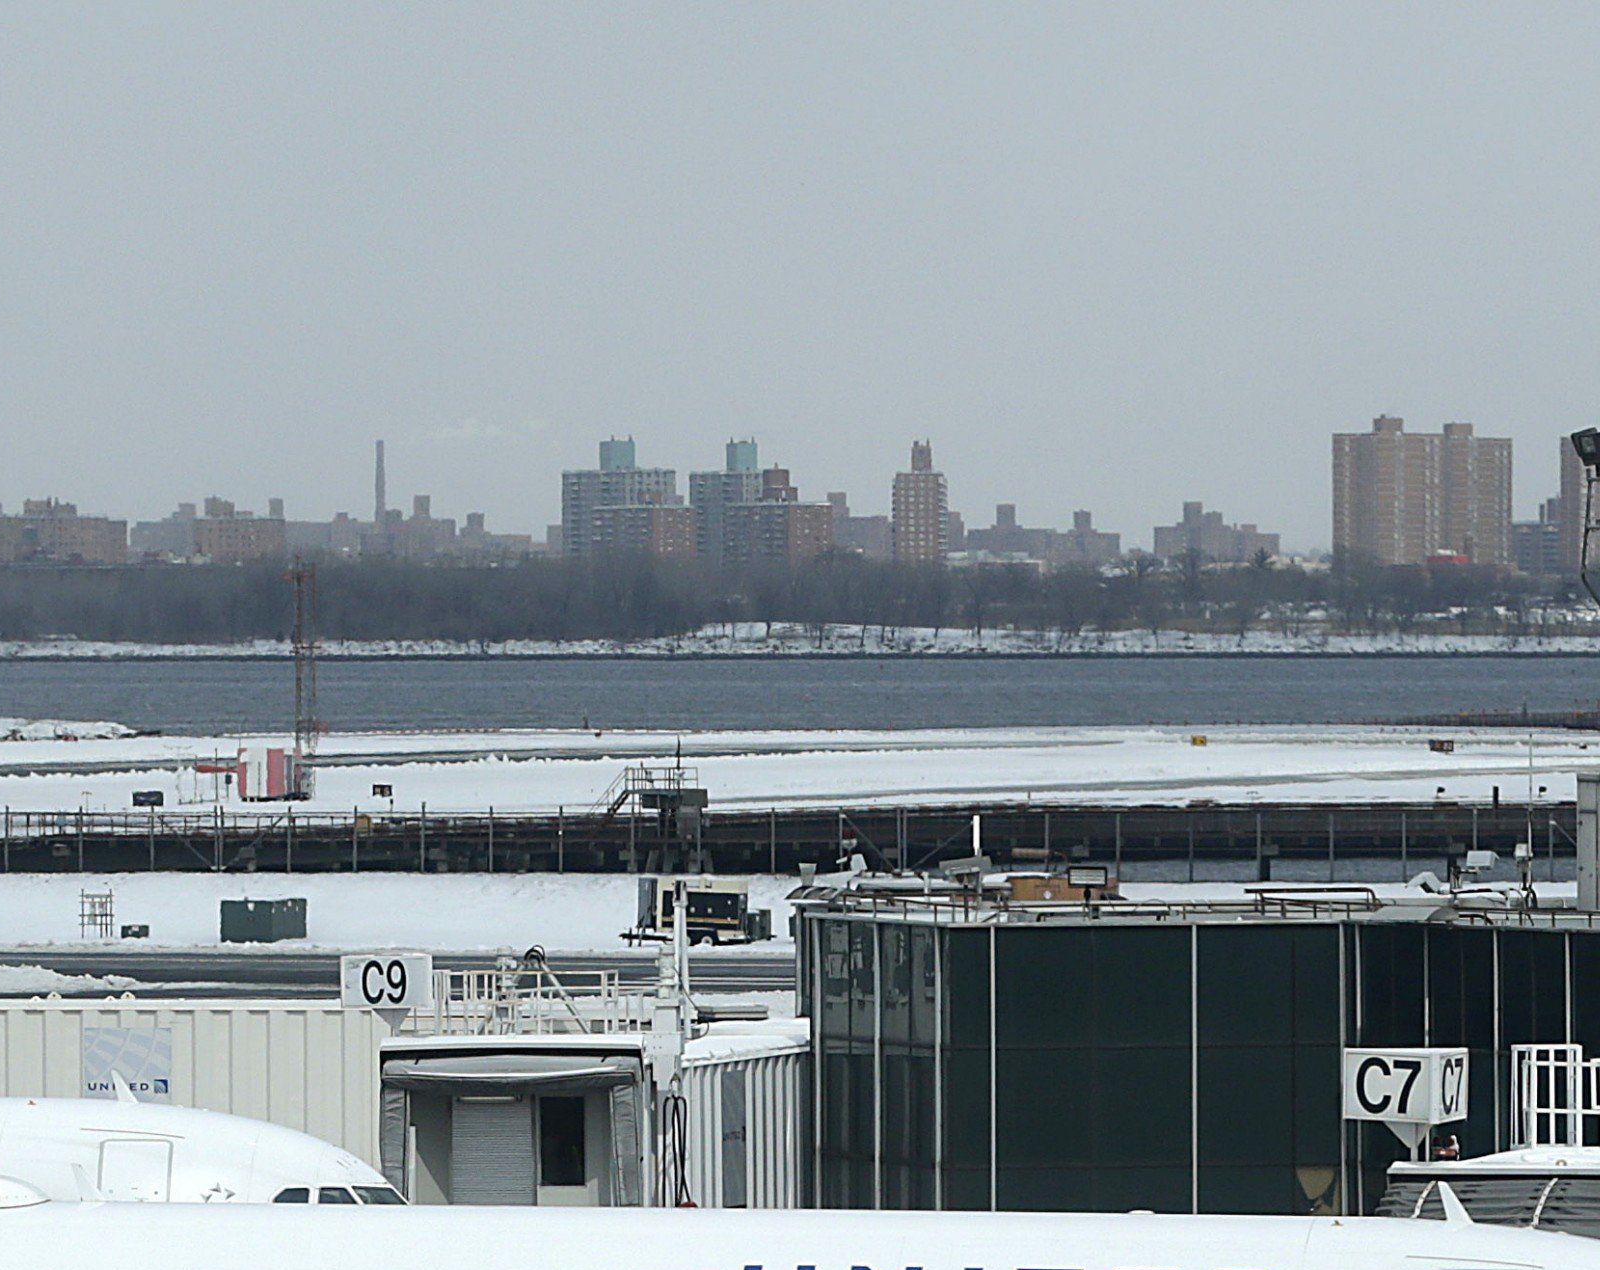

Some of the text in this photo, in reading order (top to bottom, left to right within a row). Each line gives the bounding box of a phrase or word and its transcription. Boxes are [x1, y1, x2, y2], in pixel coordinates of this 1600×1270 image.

[362, 960, 407, 1004] C9
[88, 1082, 149, 1091] UNIED
[1356, 1056, 1422, 1114] C7
[1441, 1057, 1464, 1115] C7
